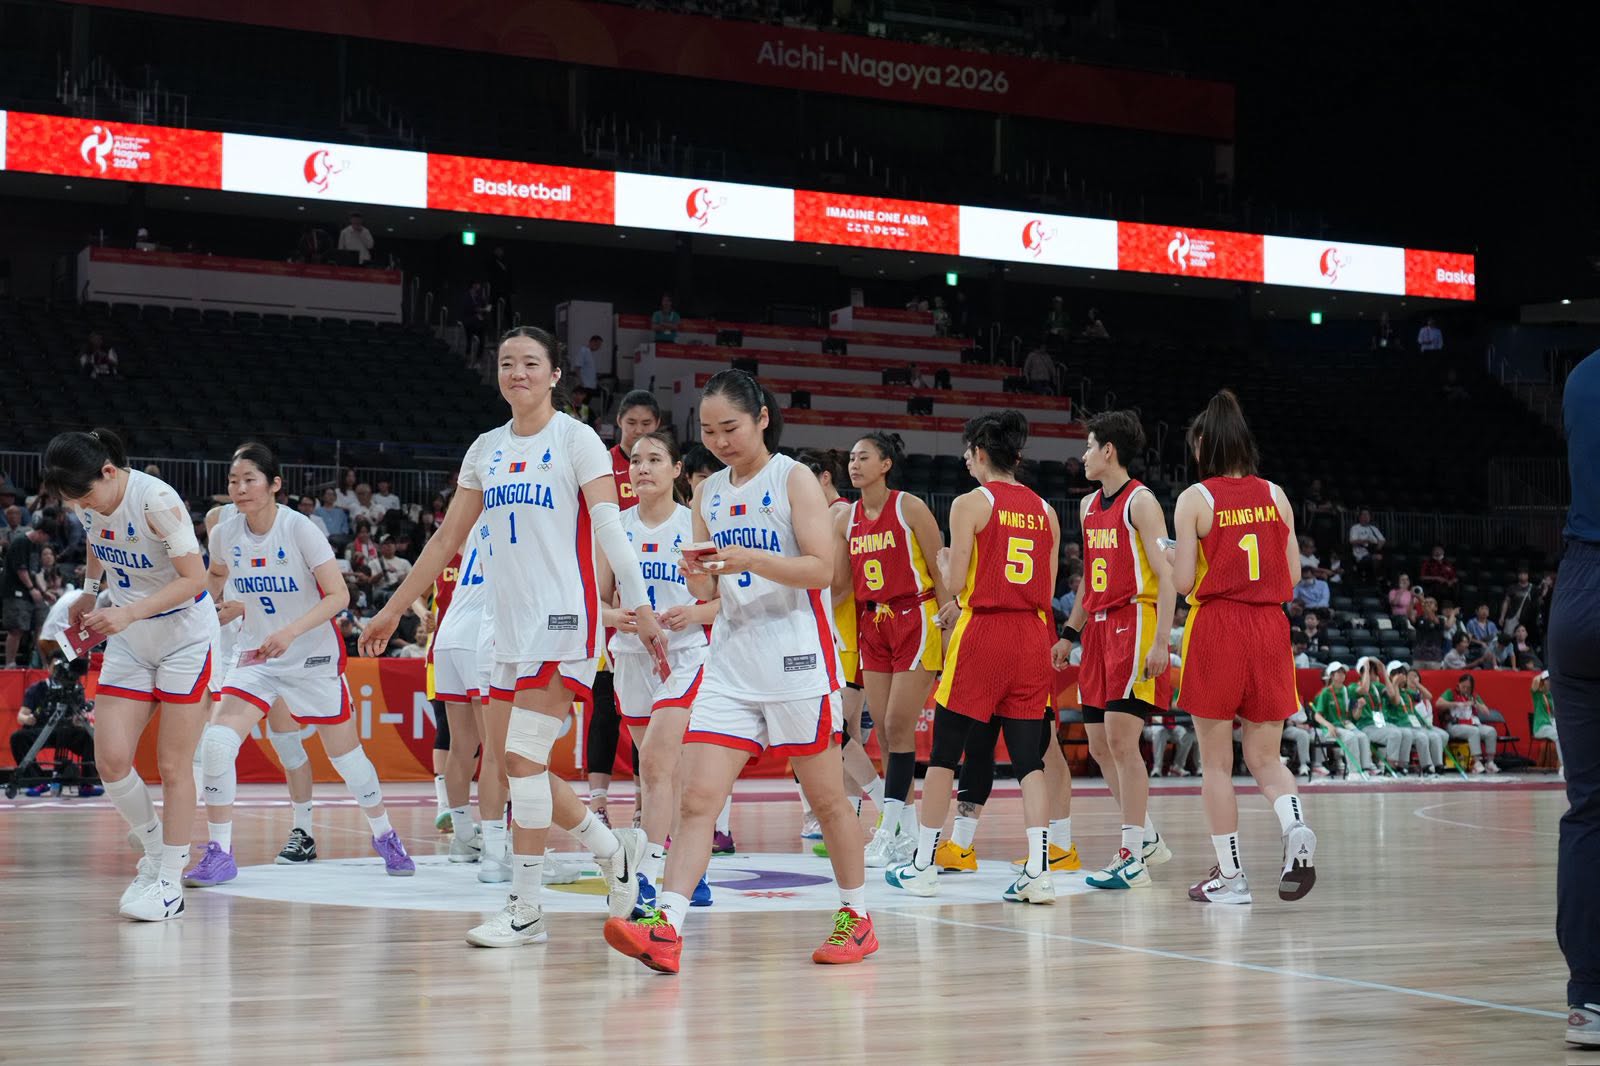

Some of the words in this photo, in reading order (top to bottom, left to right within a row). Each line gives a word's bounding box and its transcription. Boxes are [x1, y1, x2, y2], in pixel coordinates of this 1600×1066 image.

[757, 40, 941, 90] Aichi-Nagoya
[945, 64, 1009, 94] 2026
[473, 177, 572, 202] Basketball
[825, 206, 875, 221] IMAGINE
[876, 211, 901, 224] ONE
[902, 213, 929, 226] ASIA
[508, 511, 517, 544] 1
[998, 509, 1025, 529] WANG
[1028, 514, 1048, 531] S.Y.
[1216, 507, 1253, 528] ZHANG
[711, 527, 781, 553] ONGOLIA
[850, 530, 896, 555] CHINA
[91, 543, 154, 569] NGOLIA
[1004, 536, 1034, 584] 5
[1238, 533, 1260, 581] 1
[639, 561, 686, 585] GOLIA
[863, 559, 884, 592] 9
[1091, 557, 1107, 593] 6
[259, 596, 276, 615] 9
